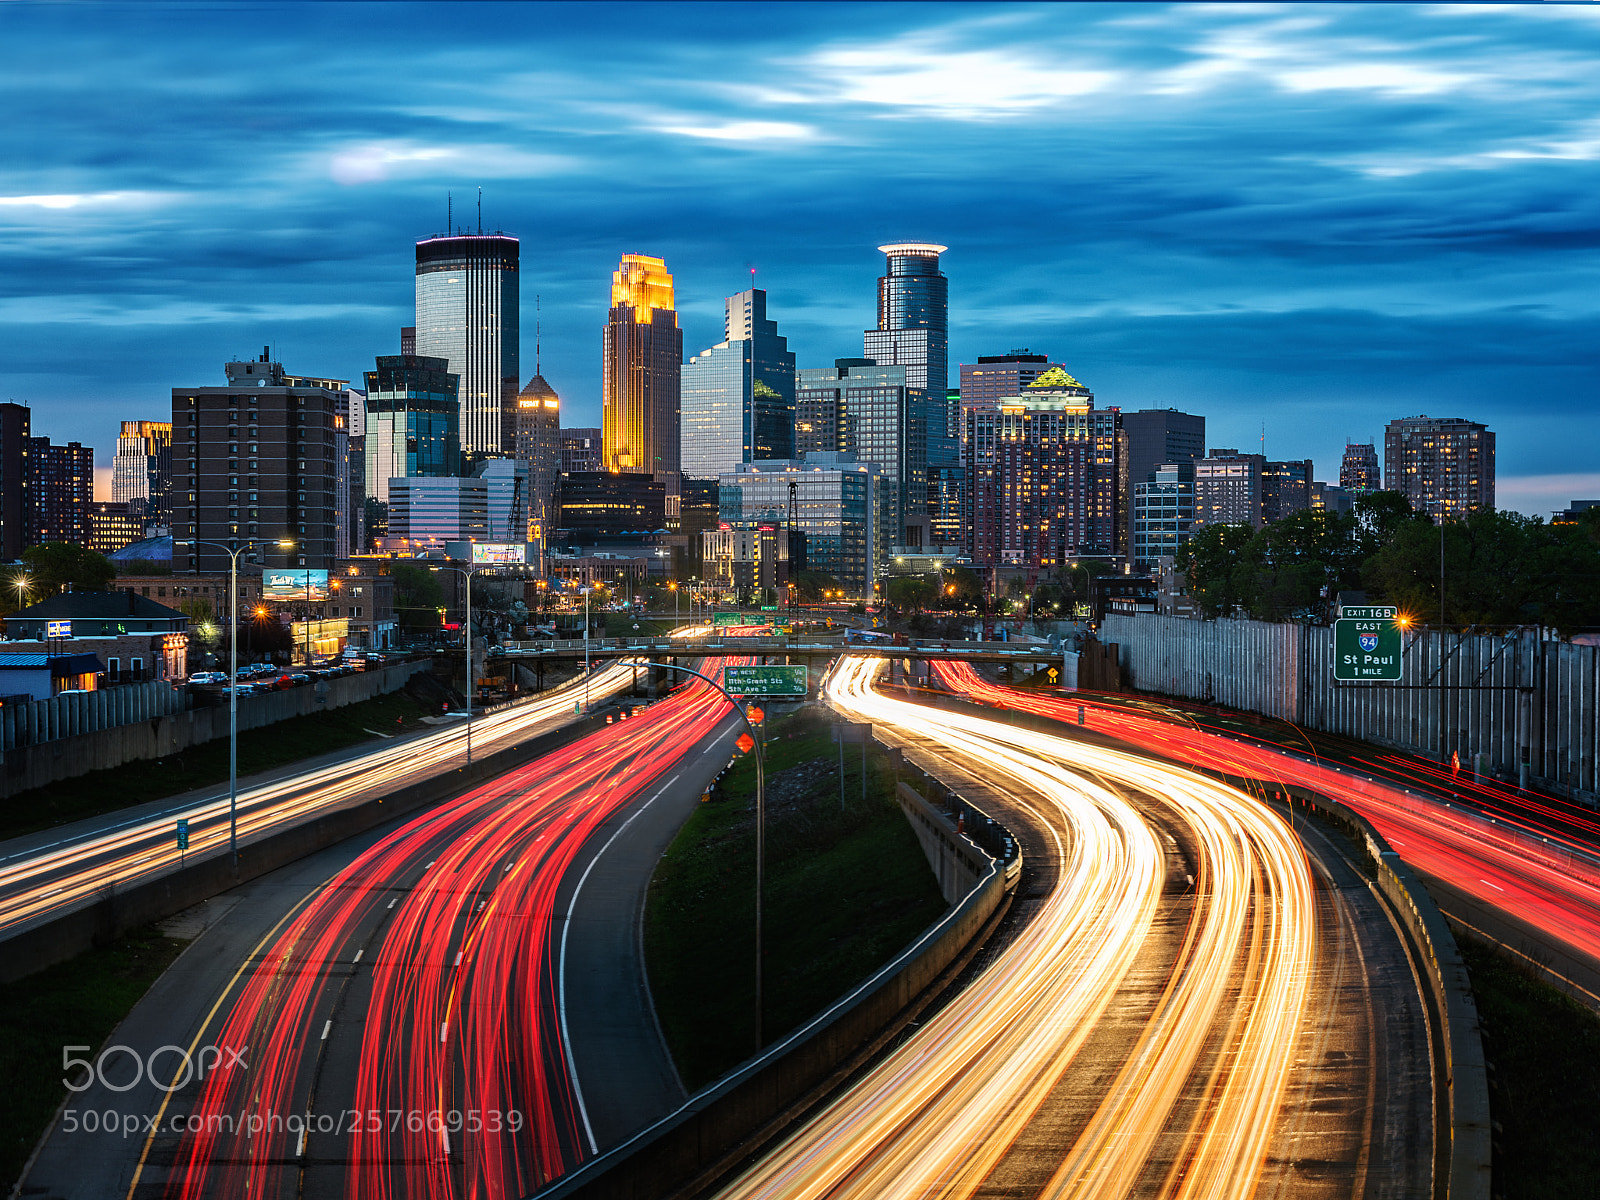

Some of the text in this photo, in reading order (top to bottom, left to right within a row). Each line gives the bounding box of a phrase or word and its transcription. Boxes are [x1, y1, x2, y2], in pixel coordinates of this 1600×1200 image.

[1347, 608, 1391, 618] EXIT 16B
[1355, 622, 1382, 631] EAST
[1361, 637, 1375, 647] 94
[1343, 654, 1393, 665] St Paul
[1353, 667, 1359, 676] 1
